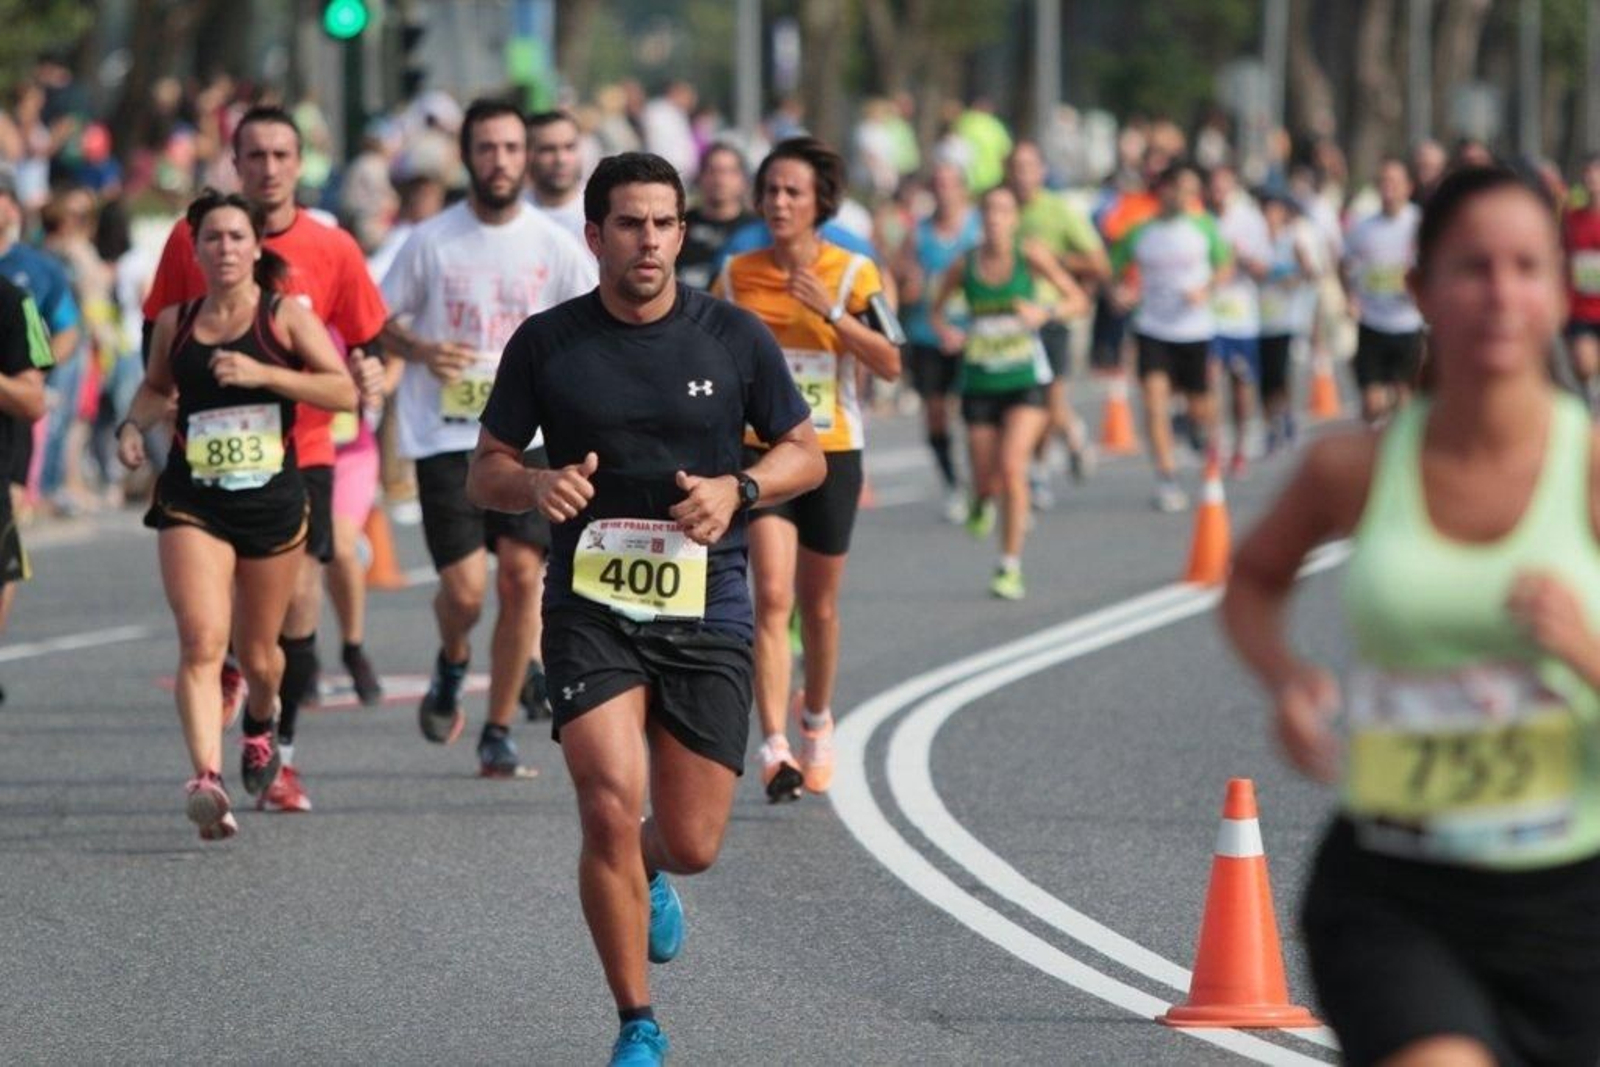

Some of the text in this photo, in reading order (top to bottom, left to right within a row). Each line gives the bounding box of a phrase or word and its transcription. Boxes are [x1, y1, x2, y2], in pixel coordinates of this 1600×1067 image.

[796, 383, 822, 408] 5
[207, 436, 263, 467] 883
[599, 558, 680, 599] 400
